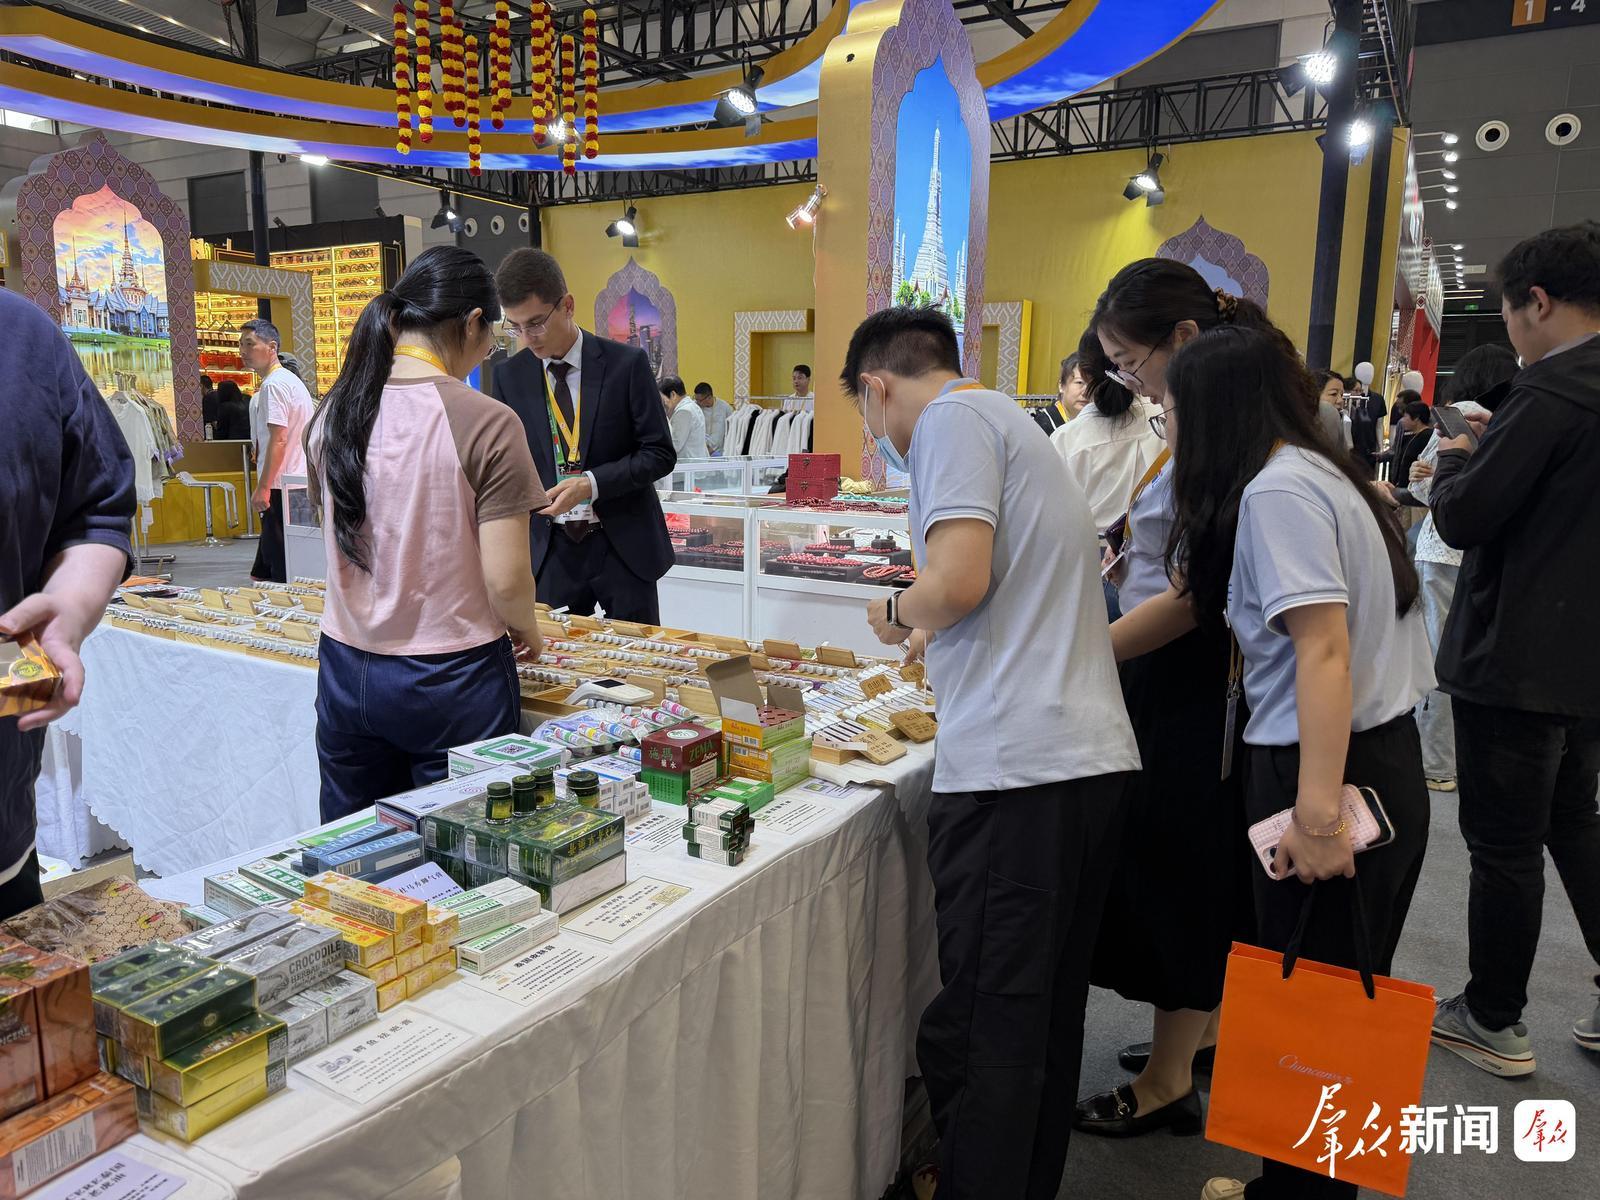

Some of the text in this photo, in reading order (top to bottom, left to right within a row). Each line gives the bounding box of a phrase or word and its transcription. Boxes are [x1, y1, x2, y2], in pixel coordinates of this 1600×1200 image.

[1524, 0, 1534, 21] 1
[688, 740, 714, 763] ZEMA
[289, 939, 342, 974] CROCODILE
[290, 964, 321, 984] HERBAL
